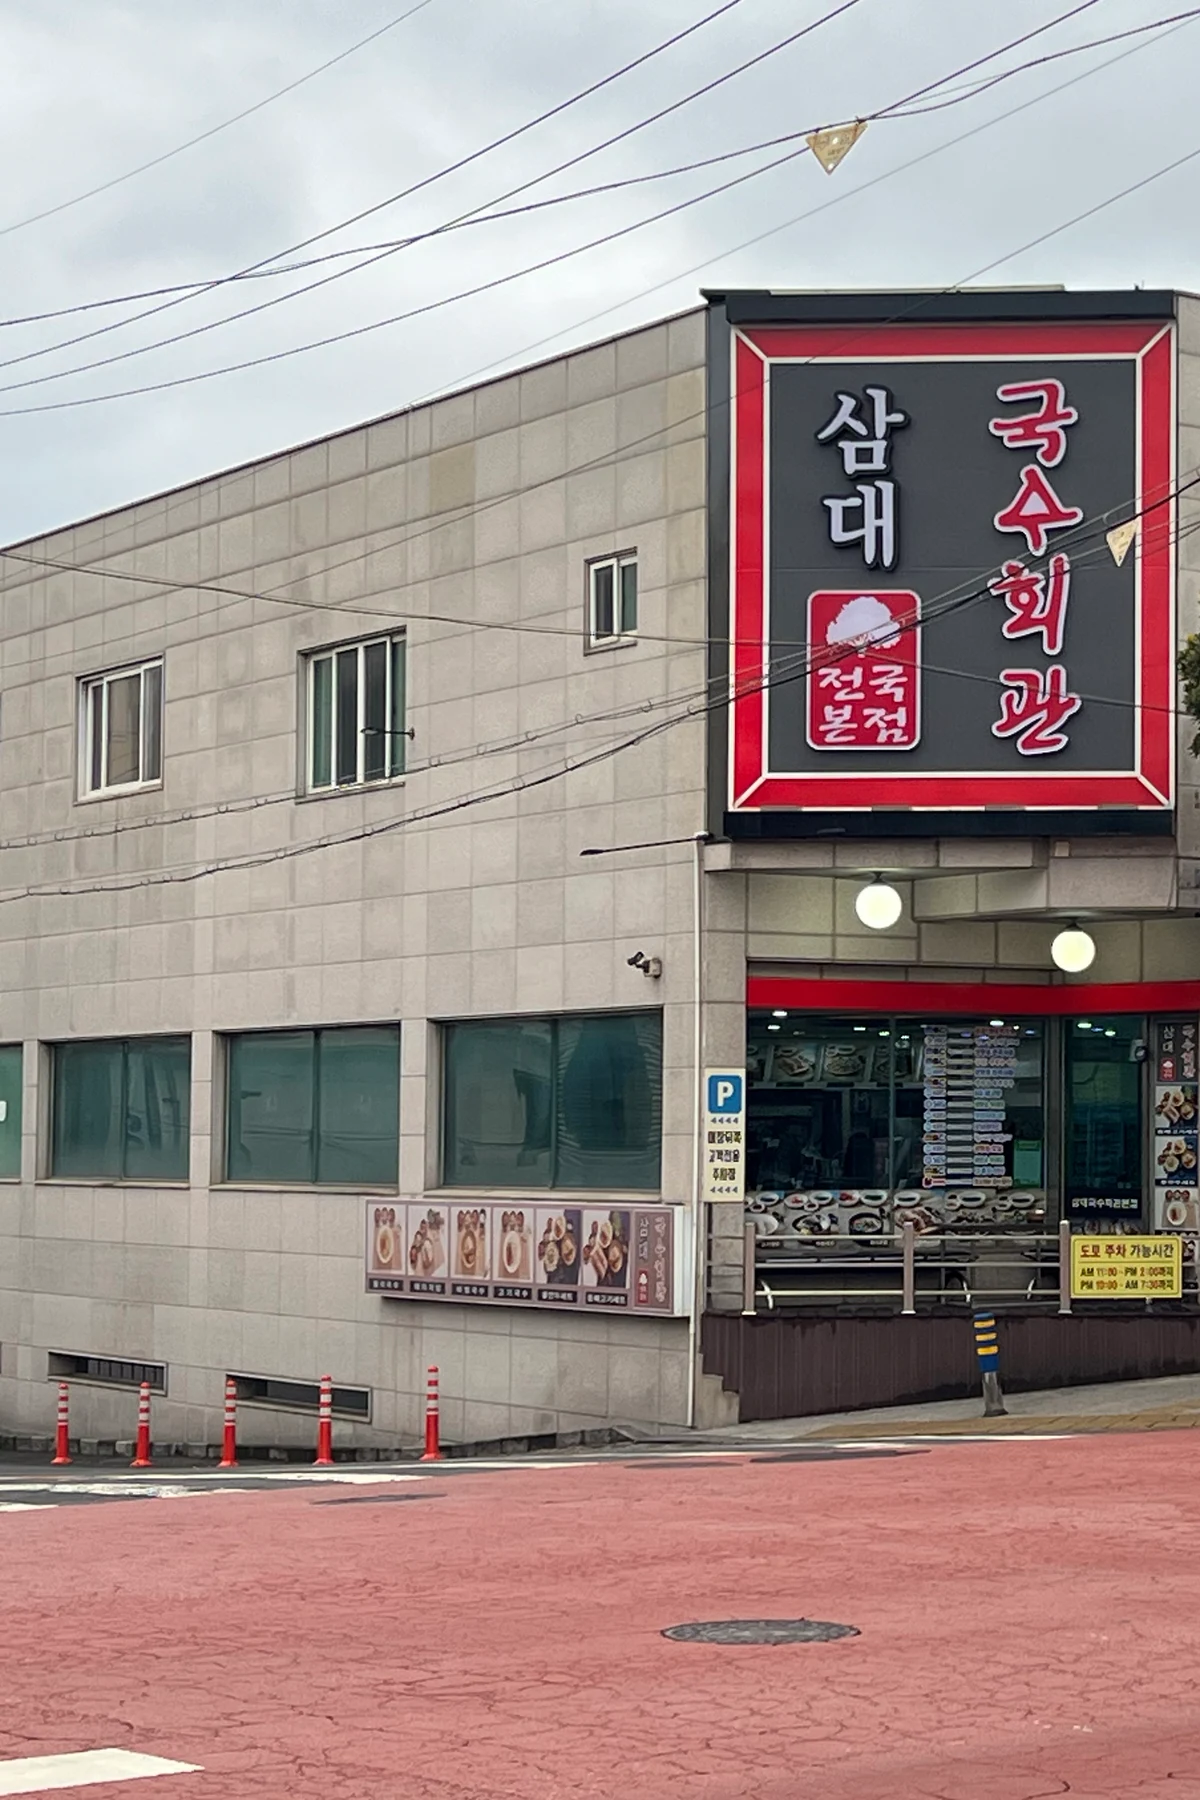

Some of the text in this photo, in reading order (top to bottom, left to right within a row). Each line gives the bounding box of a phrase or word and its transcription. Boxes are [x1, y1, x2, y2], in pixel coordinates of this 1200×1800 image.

[814, 385, 910, 570] 삼대
[989, 377, 1083, 756] 국수회관
[817, 664, 908, 702] 전국
[818, 704, 909, 744] 본점
[717, 1081, 734, 1107] P
